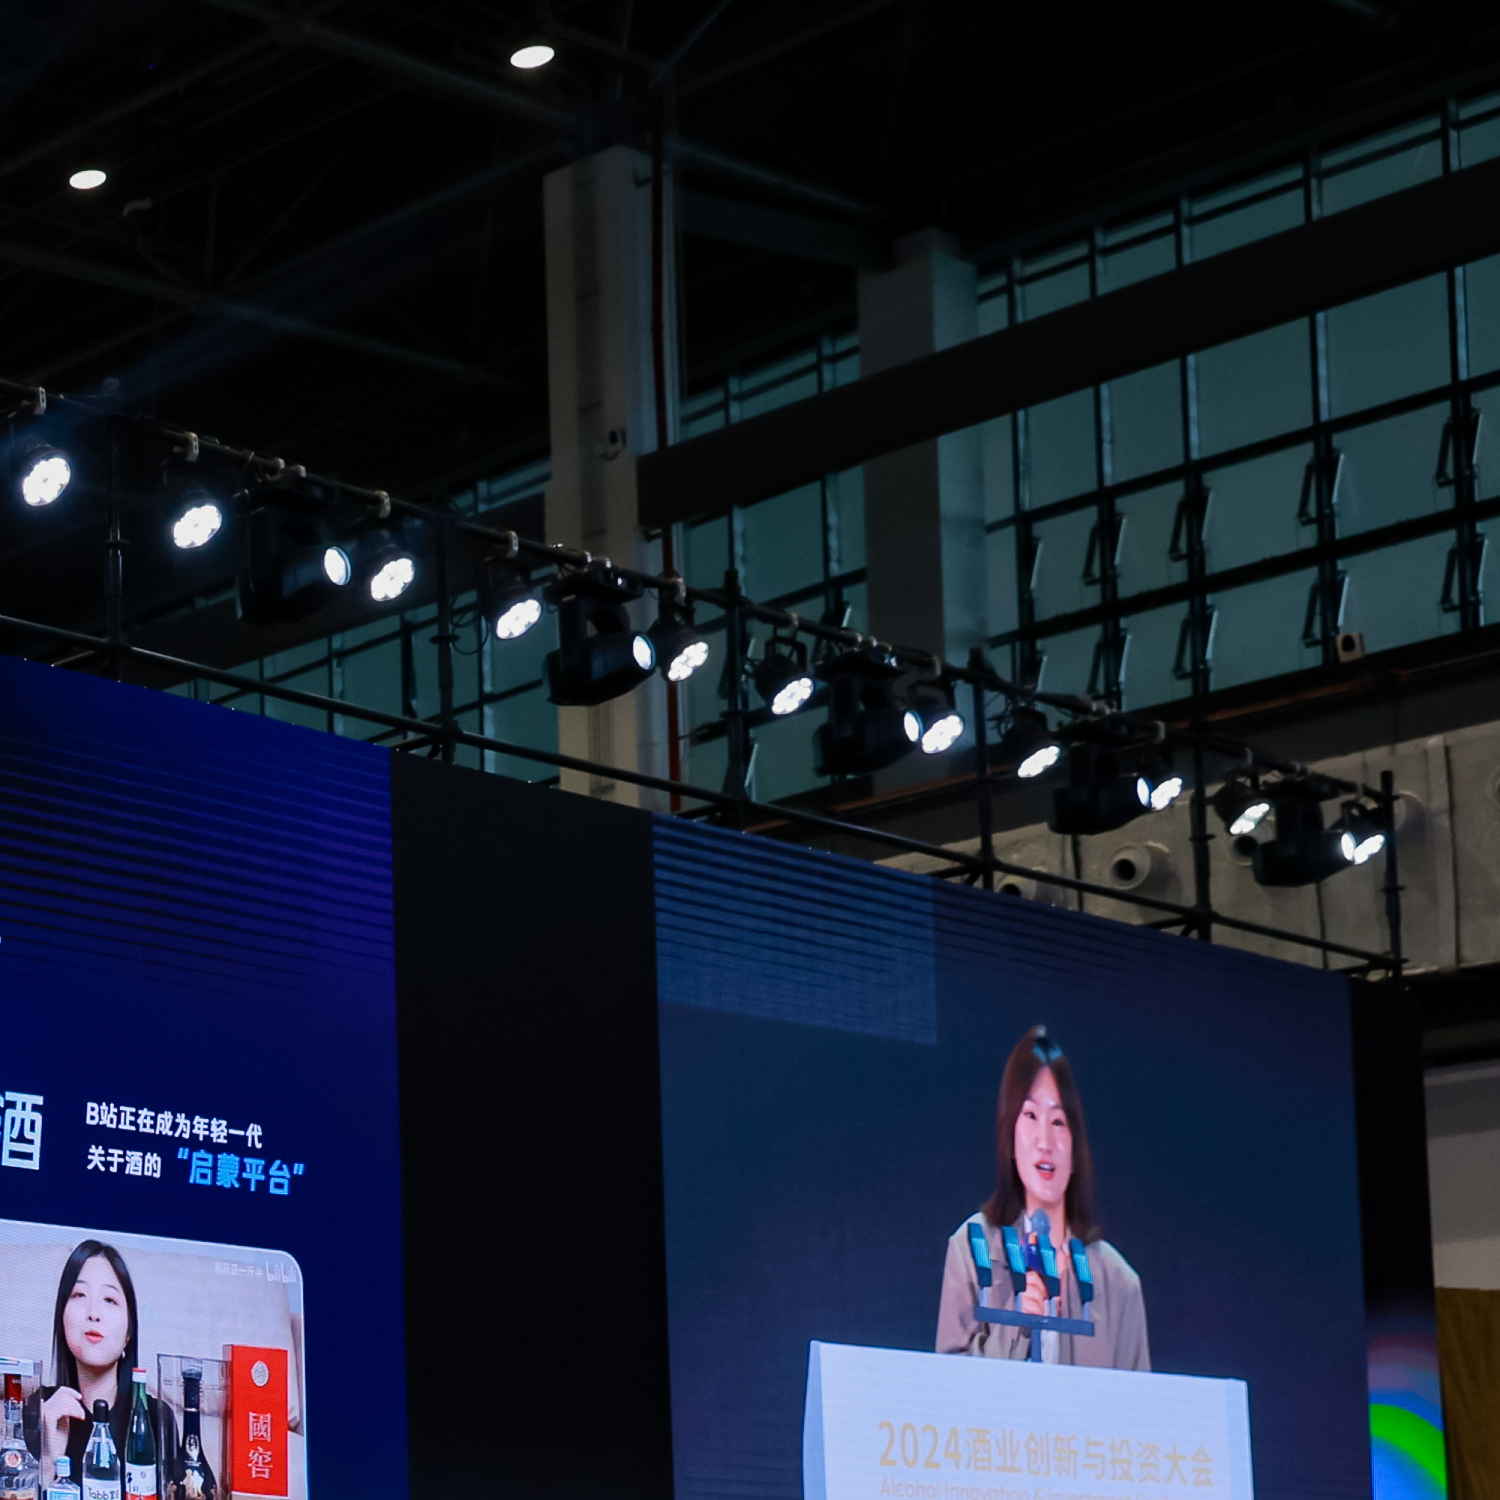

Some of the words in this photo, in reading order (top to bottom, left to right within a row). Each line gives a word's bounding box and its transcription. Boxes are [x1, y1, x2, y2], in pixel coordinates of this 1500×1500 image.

[85, 1102, 264, 1149] B站正在成为年轻一代
[877, 1420, 1215, 1488] 2024酒业创新与投资大会
